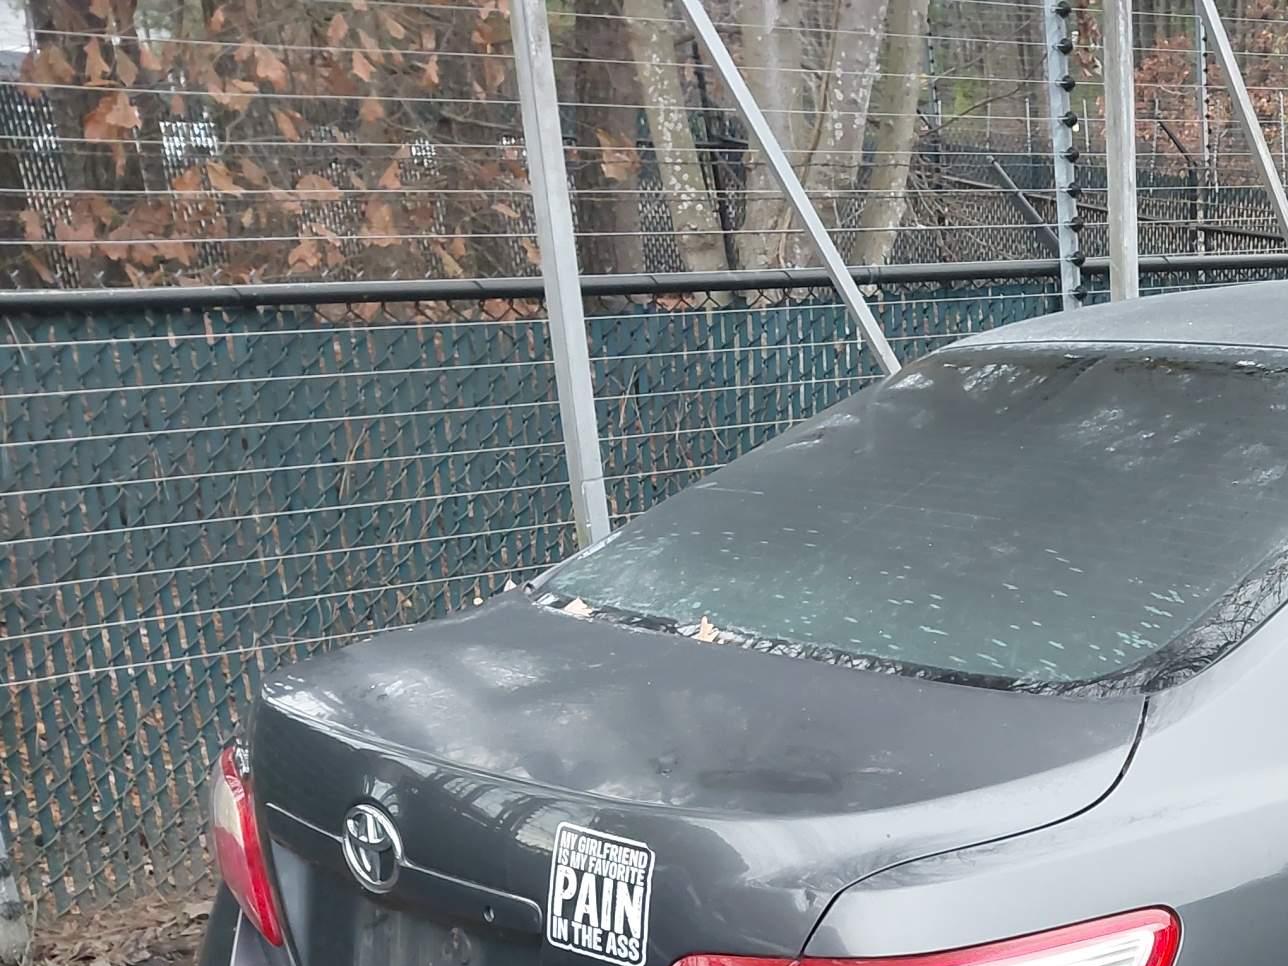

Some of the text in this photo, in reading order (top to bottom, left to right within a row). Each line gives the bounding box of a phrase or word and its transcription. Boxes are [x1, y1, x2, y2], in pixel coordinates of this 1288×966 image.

[558, 847, 646, 887] IS MY FAVORITE
[560, 830, 649, 869] MY GIRLFRIEND
[553, 865, 644, 939] PAIN
[552, 915, 640, 962] IN THE ASS
